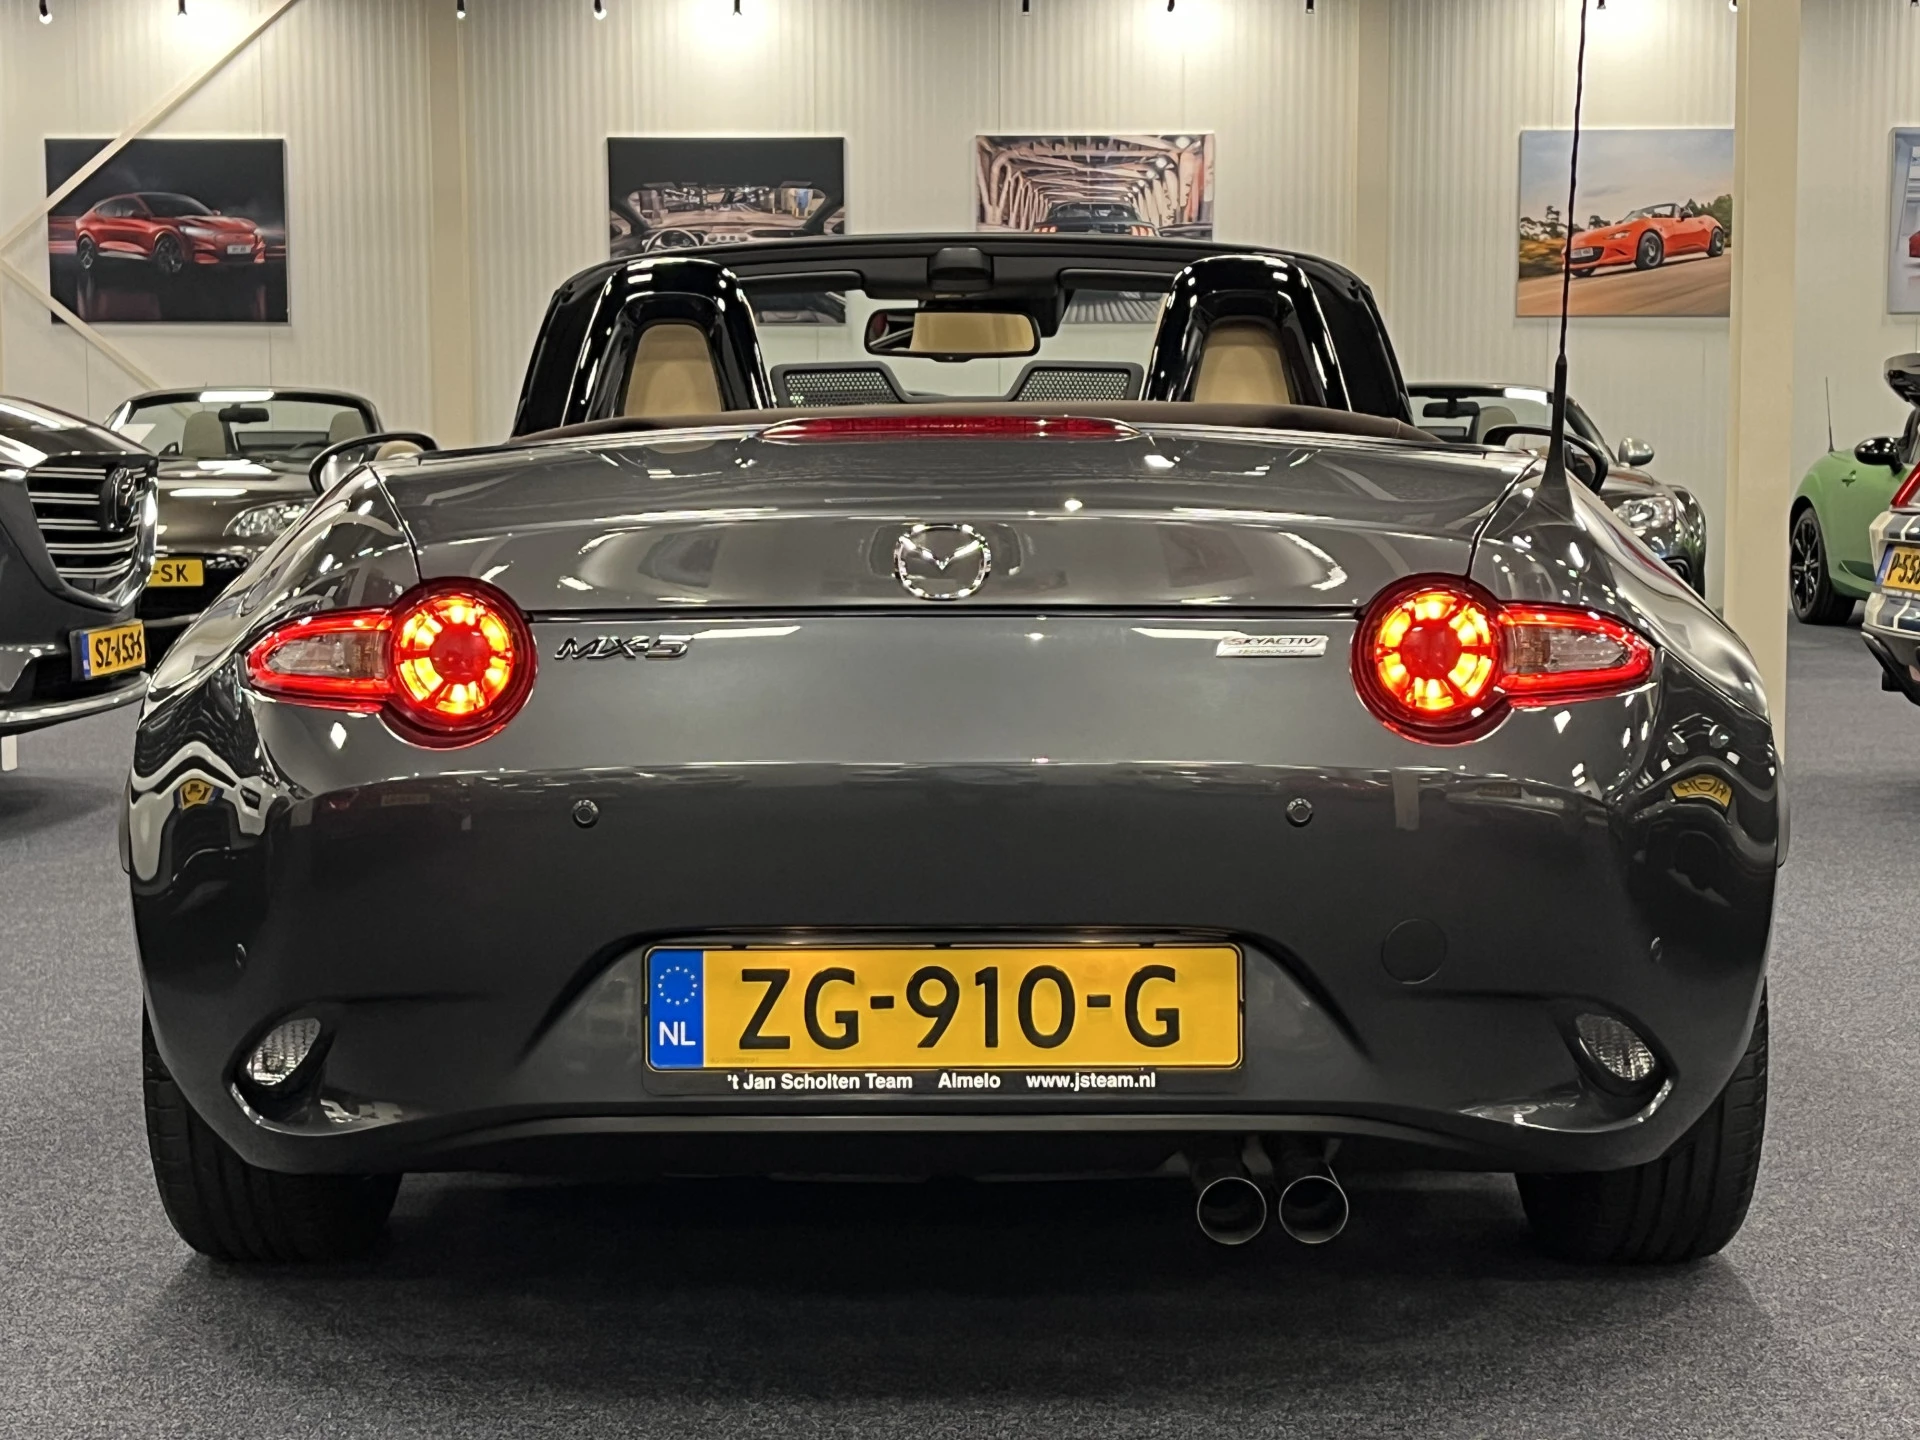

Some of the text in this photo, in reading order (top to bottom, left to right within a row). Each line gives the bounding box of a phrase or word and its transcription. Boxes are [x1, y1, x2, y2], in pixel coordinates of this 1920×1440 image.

[554, 634, 689, 660] MX-5
[739, 965, 1180, 1050] ZG-910-G
[659, 1021, 696, 1046] NL
[743, 1073, 776, 1090] Jan
[780, 1073, 860, 1090] Scholten
[864, 1073, 913, 1089] Team
[938, 1072, 1001, 1089] Almelo
[1026, 1072, 1156, 1091] www.jsteam.nl
